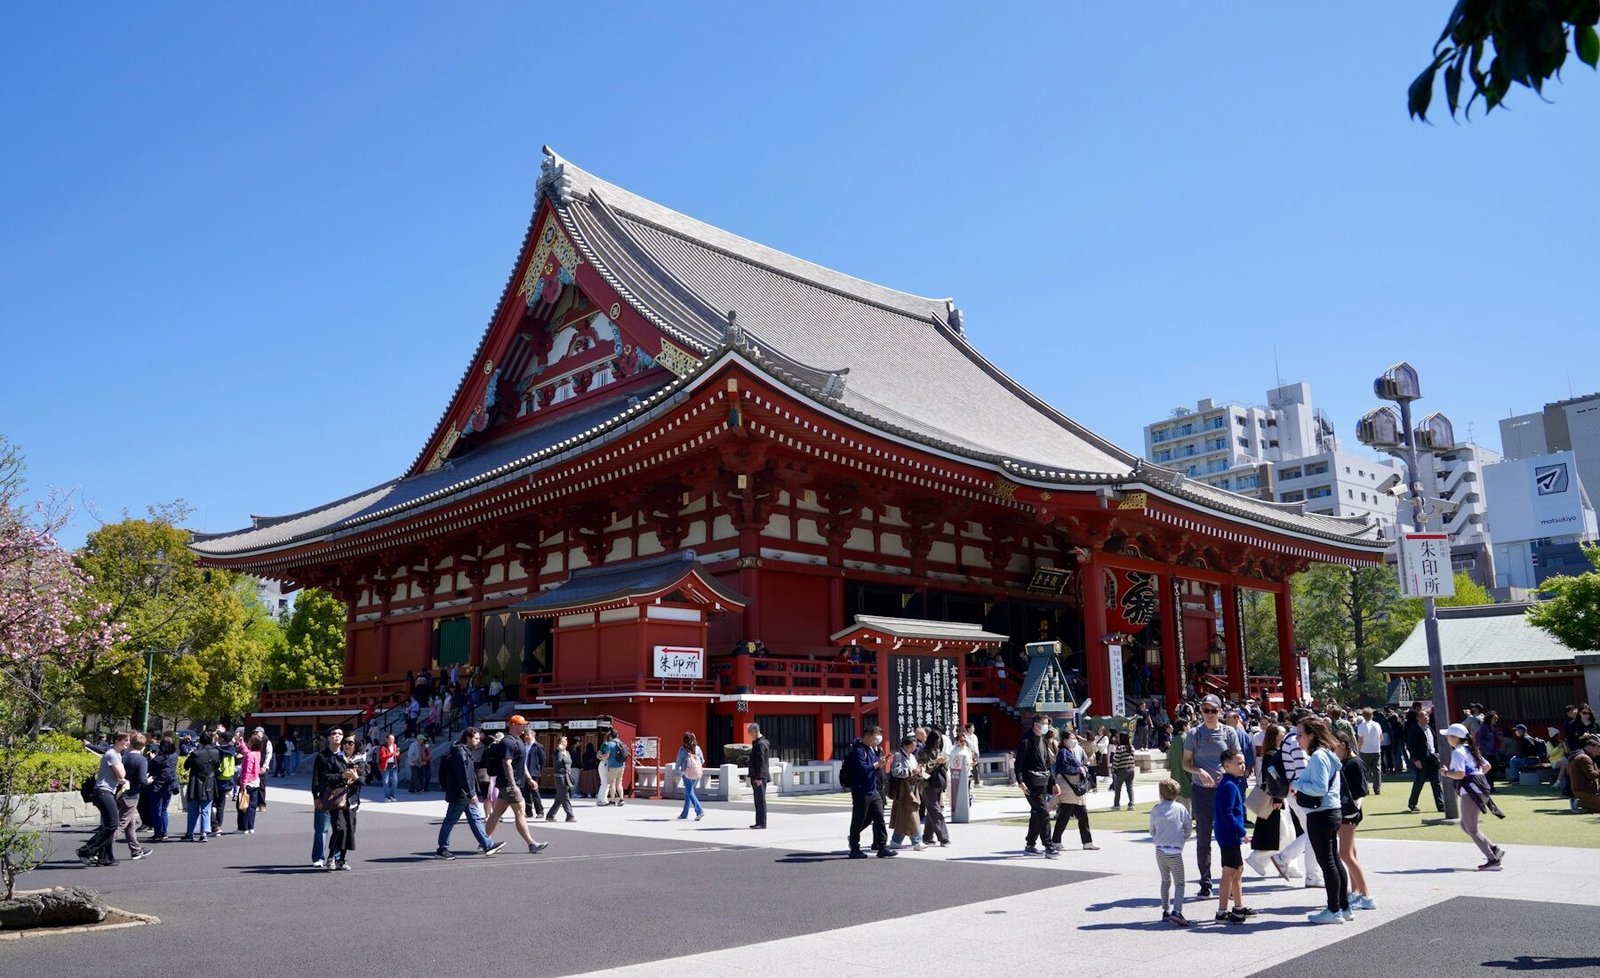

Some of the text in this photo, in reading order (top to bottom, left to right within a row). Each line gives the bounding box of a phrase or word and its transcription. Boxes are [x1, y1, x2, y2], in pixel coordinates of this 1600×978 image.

[1541, 516, 1577, 524] matsukiyo
[1421, 541, 1440, 594] 朱印所
[660, 655, 698, 673] 朱印所
